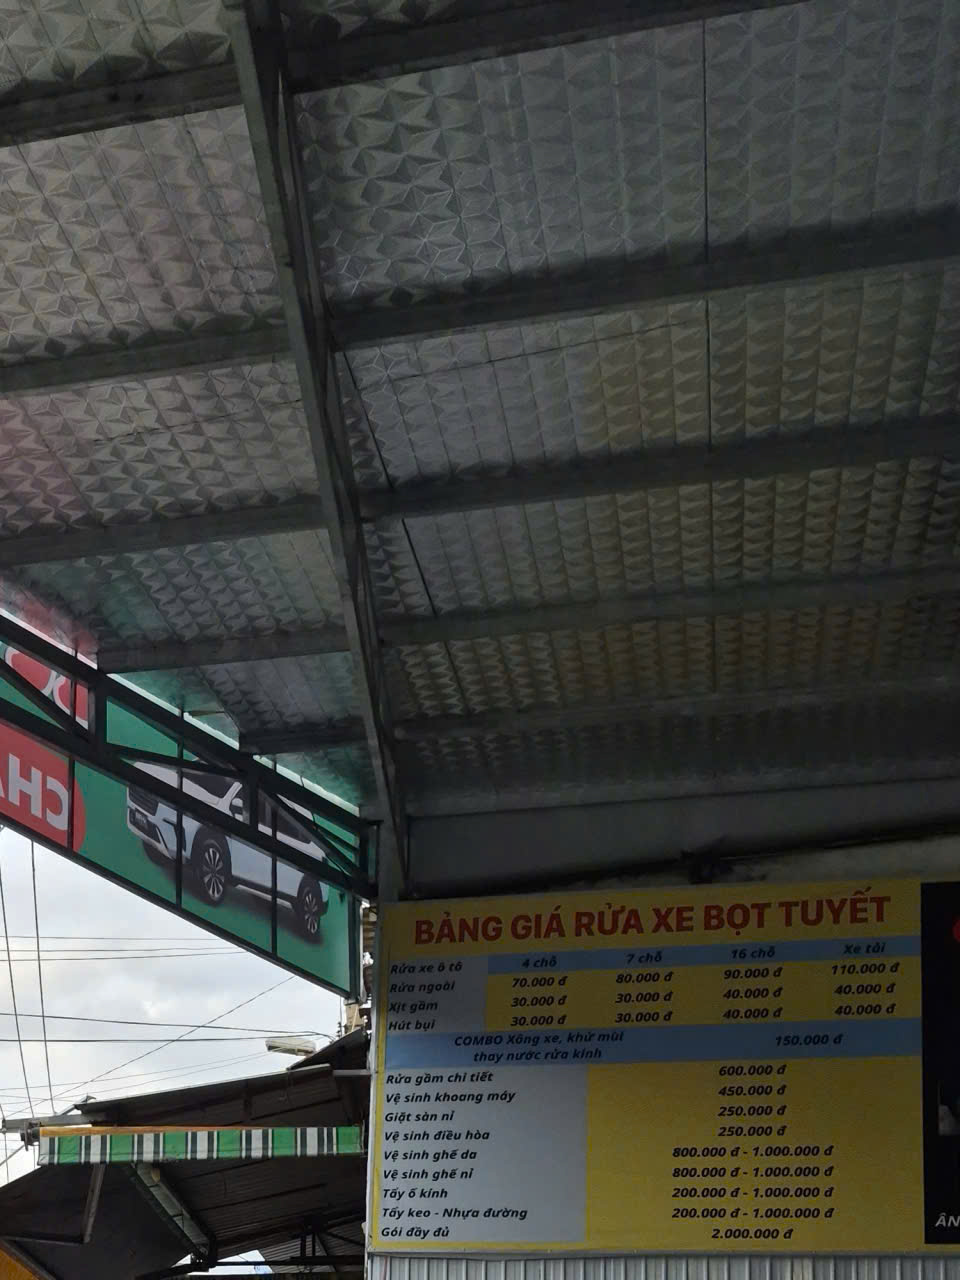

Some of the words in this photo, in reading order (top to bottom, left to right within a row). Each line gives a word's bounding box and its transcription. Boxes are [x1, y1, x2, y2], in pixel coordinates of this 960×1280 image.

[414, 911, 503, 945] BẢNG
[510, 905, 566, 940] GIÁ
[575, 902, 644, 937] RỬA
[651, 905, 695, 933] XE
[703, 902, 772, 936] BỌT
[778, 886, 891, 927] TUYẾT
[731, 948, 747, 960] 16
[843, 944, 862, 955] Xe
[522, 958, 530, 969] 4
[627, 954, 635, 965] 7
[390, 963, 416, 975] Rửa
[418, 964, 434, 973] xe
[437, 961, 445, 972] ô
[448, 960, 463, 972] tô
[724, 967, 770, 980] 90.000
[772, 966, 783, 978] đ
[831, 963, 886, 975] 110.000
[889, 962, 900, 973] đ
[512, 977, 555, 988] 70.000
[557, 975, 568, 987] đ
[615, 972, 660, 984] 80.000
[663, 971, 674, 982] đ
[389, 982, 415, 993] Rửa
[418, 981, 455, 994] ngoài
[723, 988, 769, 999] 40.000
[772, 987, 783, 998] đ
[834, 983, 882, 995] 40.000
[885, 982, 896, 993] đ
[511, 996, 554, 1007] 30.000
[557, 995, 568, 1006] đ
[615, 992, 660, 1004] 30.000
[663, 990, 674, 1002] đ
[388, 1002, 407, 1013] Xịt
[410, 1000, 438, 1014] gầm
[722, 1008, 769, 1019] 40.000
[834, 1004, 882, 1016] 40.000
[510, 1016, 554, 1027] 30.000
[615, 1012, 660, 1023] 30.000
[388, 1020, 412, 1031] Hút
[414, 1019, 435, 1032] bụi
[454, 1035, 503, 1046] COMBO
[506, 1033, 540, 1047] Xông
[543, 1034, 562, 1045] xe,
[567, 1031, 595, 1043] khử
[775, 1034, 830, 1046] 150.000
[474, 1051, 503, 1064] thay
[506, 1050, 542, 1061] nước
[544, 1048, 569, 1060] rửa
[572, 1048, 602, 1059] kính
[719, 1065, 773, 1077] 600.000
[386, 1074, 412, 1084] Rửa
[415, 1073, 444, 1086] gầm
[447, 1072, 467, 1083] chi
[470, 1071, 494, 1082] tiết
[386, 1093, 401, 1105] Vệ
[404, 1092, 431, 1103] sinh
[434, 1092, 483, 1104] khoang
[487, 1090, 516, 1103] máy
[718, 1085, 773, 1097] 450.000
[385, 1112, 411, 1124] Giặt
[415, 1112, 438, 1122] sàn
[441, 1110, 455, 1121] nỉ
[718, 1105, 773, 1117] 250.000
[385, 1131, 400, 1143] Vệ
[403, 1131, 430, 1141] sinh
[433, 1129, 462, 1141] điều
[465, 1129, 490, 1140] hòa
[718, 1126, 773, 1137] 250.000
[384, 1150, 399, 1162] Vệ
[402, 1150, 429, 1160] sinh
[432, 1149, 458, 1163] ghế
[460, 1149, 477, 1160] da
[672, 1147, 727, 1158] 800.000
[730, 1146, 741, 1157] đ
[752, 1146, 820, 1157] 1.000.000
[383, 1169, 398, 1181] Vệ
[401, 1169, 428, 1179] sinh
[432, 1168, 458, 1182] ghế
[460, 1167, 474, 1179] nỉ
[672, 1167, 727, 1178] 800.000
[730, 1167, 741, 1178] đ
[753, 1166, 820, 1178] 1.000.000
[383, 1187, 405, 1201] Tẩy
[408, 1187, 417, 1199] ố
[419, 1188, 448, 1198] kính
[672, 1187, 727, 1198] 200.000
[730, 1187, 741, 1198] đ
[753, 1187, 820, 1198] 1.000.000
[382, 1207, 404, 1220] Tẩy
[407, 1208, 431, 1218] keo
[442, 1207, 480, 1220] Nhựa
[483, 1207, 528, 1221] đường
[672, 1208, 727, 1219] 200.000
[730, 1207, 741, 1218] đ
[753, 1208, 820, 1219] 1.000.000
[381, 1226, 403, 1237] Gói
[406, 1226, 430, 1240] đầy
[433, 1226, 450, 1237] đủ
[711, 1228, 780, 1239] 2.000.000
